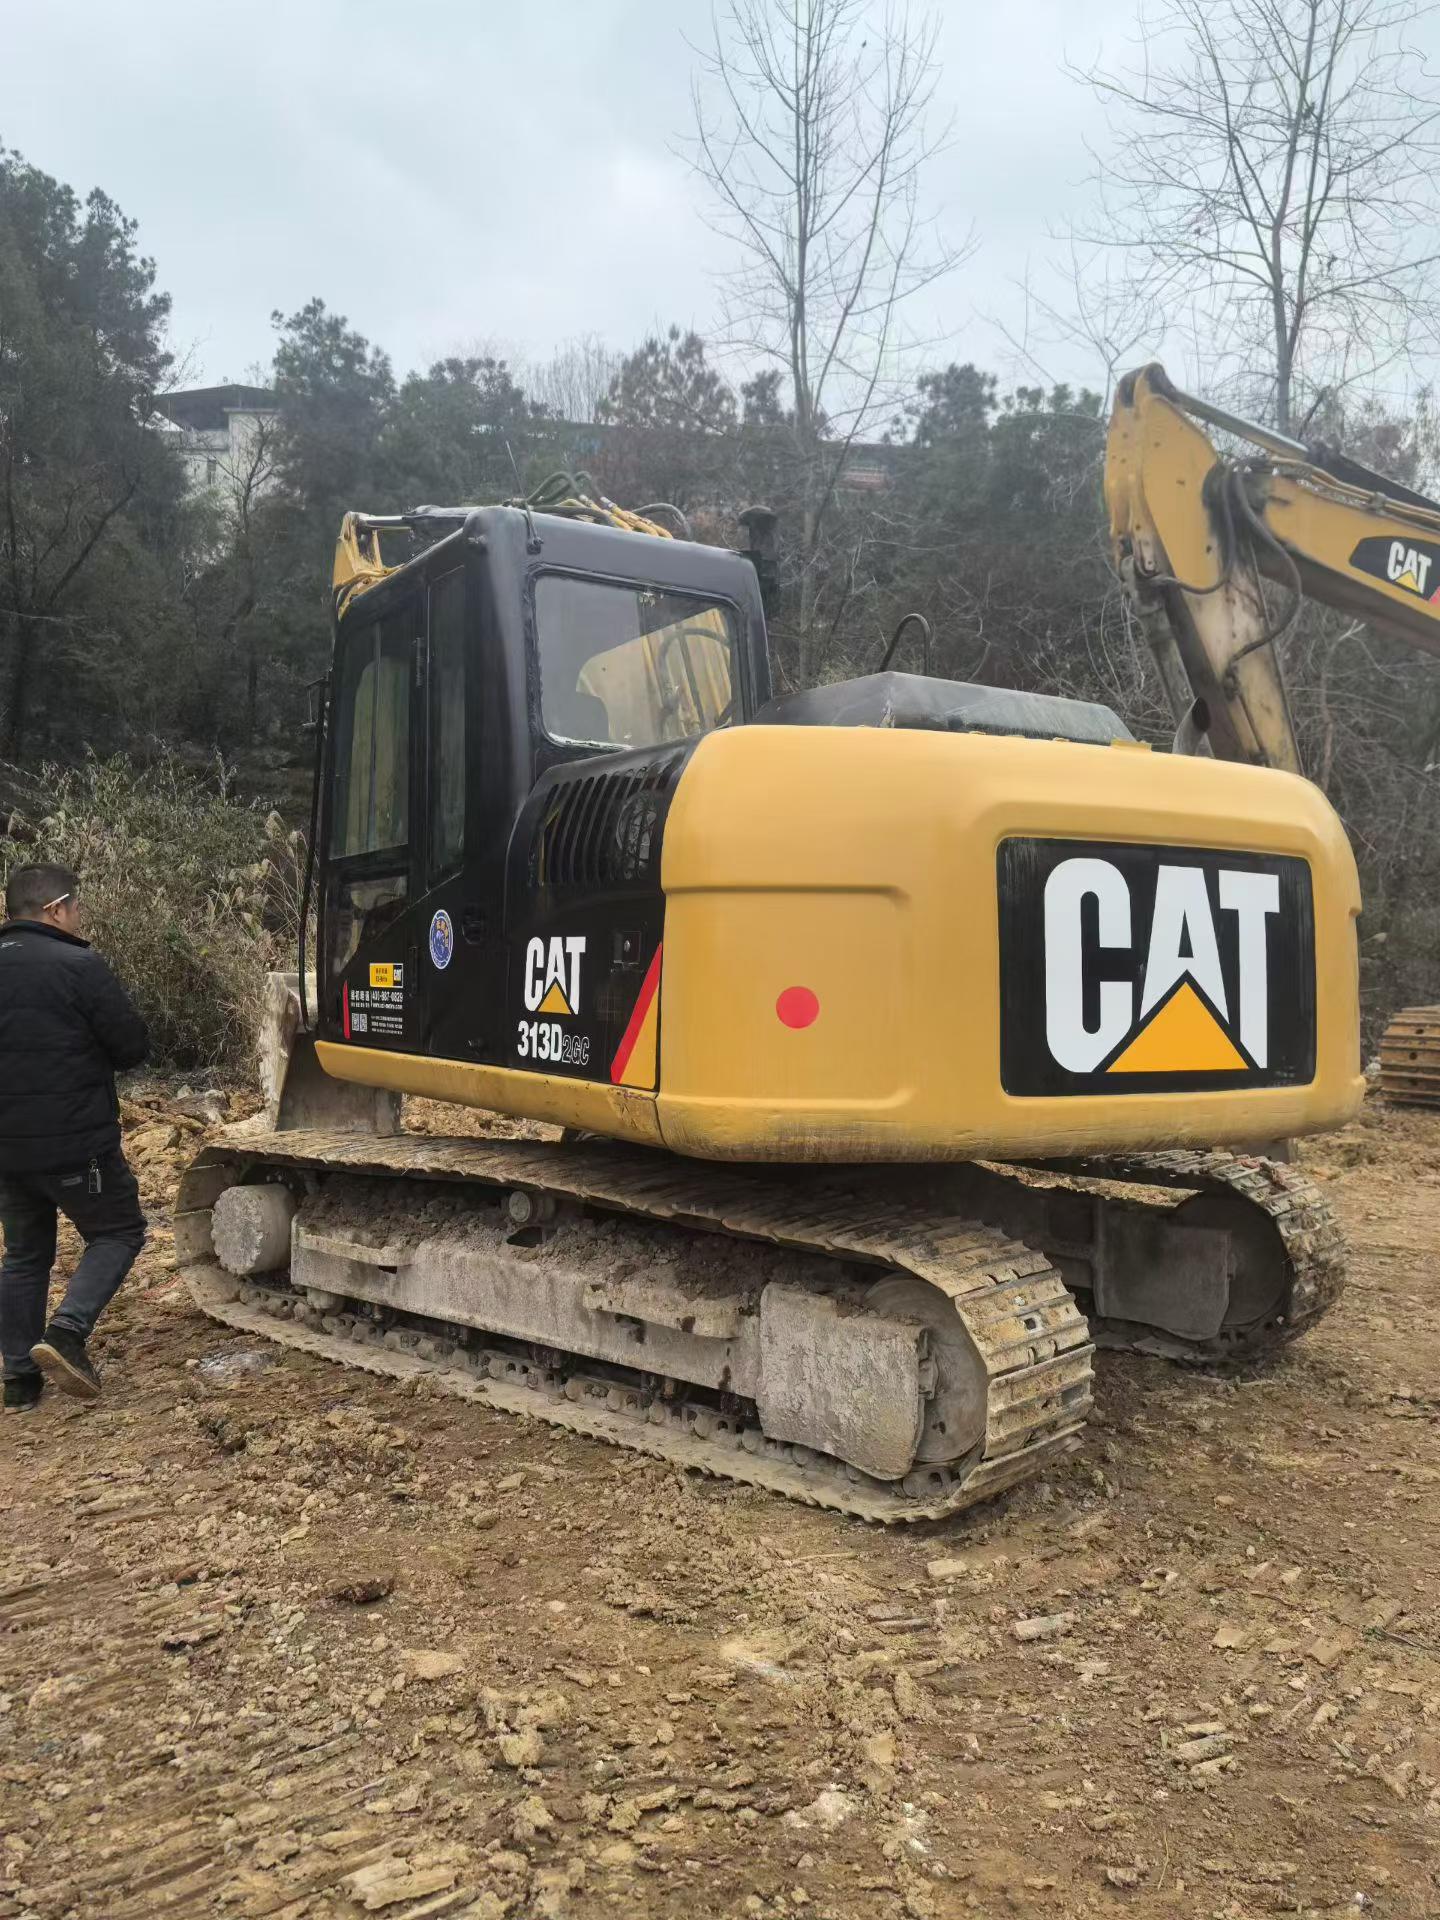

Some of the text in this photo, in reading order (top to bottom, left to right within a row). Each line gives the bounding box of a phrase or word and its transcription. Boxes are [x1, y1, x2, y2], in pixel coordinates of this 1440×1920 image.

[1387, 540, 1432, 594] CAT
[524, 936, 587, 1016] CAT
[1044, 857, 1281, 1074] CAT
